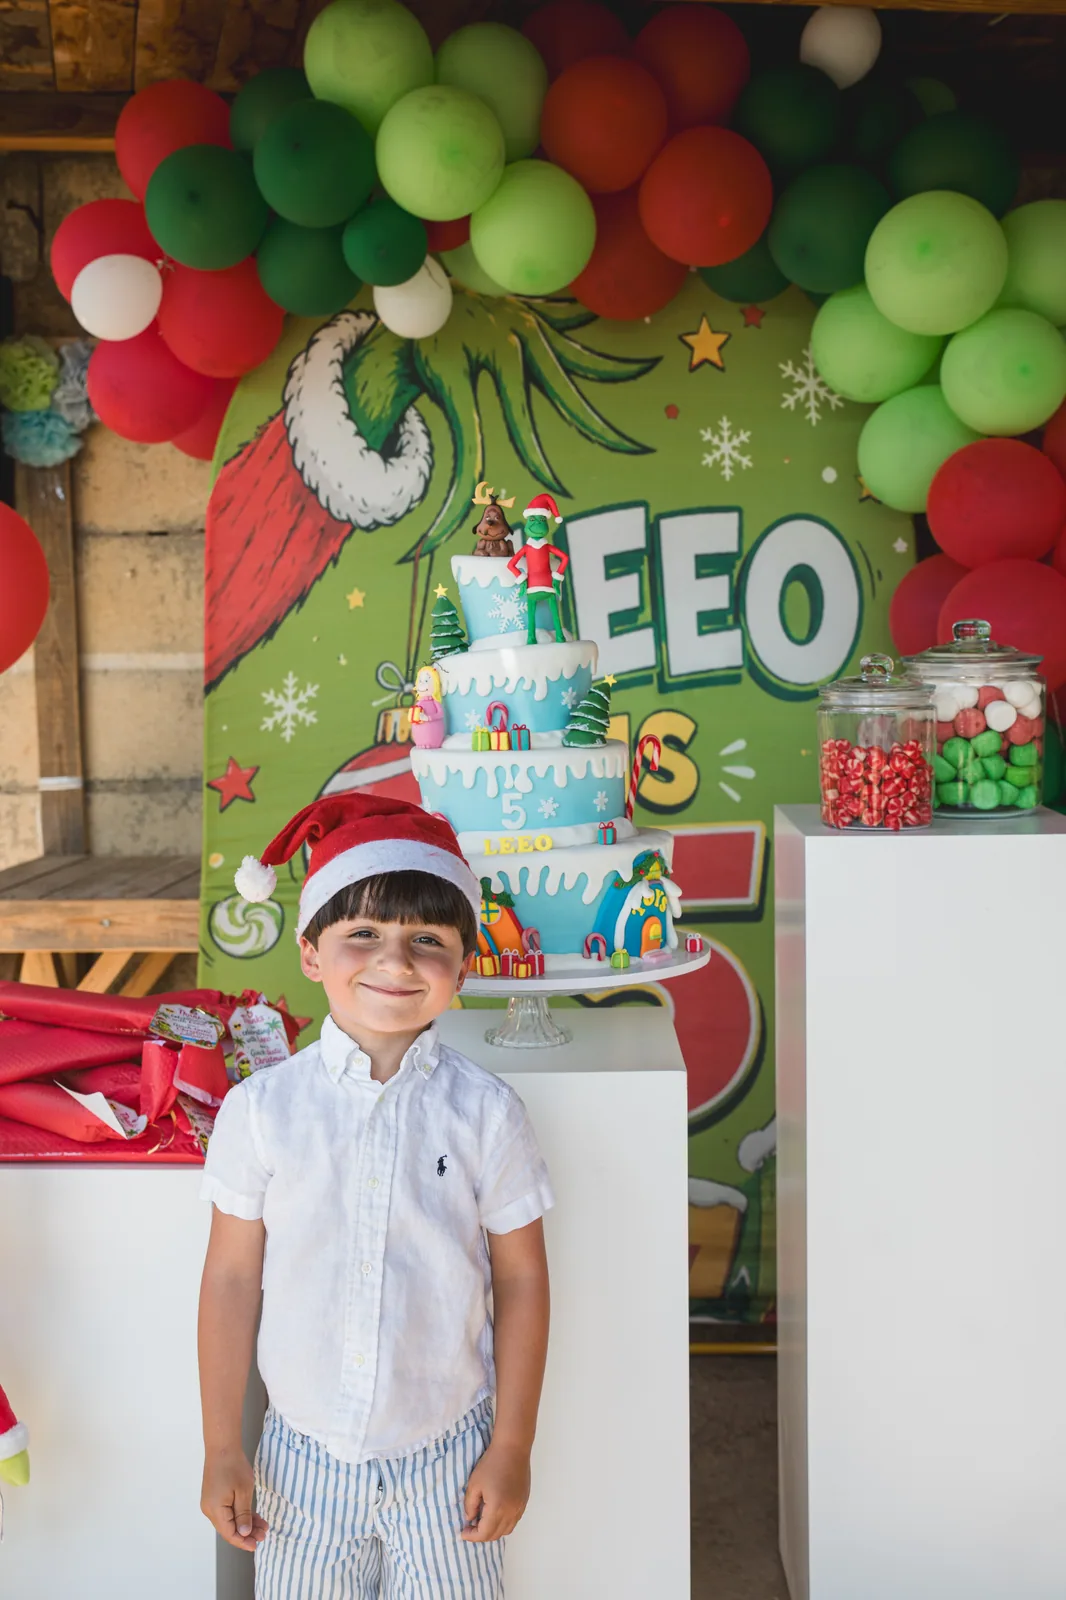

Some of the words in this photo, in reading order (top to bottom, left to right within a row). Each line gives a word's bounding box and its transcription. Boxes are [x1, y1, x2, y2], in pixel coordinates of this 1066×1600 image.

[506, 500, 863, 702] EEO
[501, 792, 526, 830] 5
[483, 834, 553, 856] LEEO
